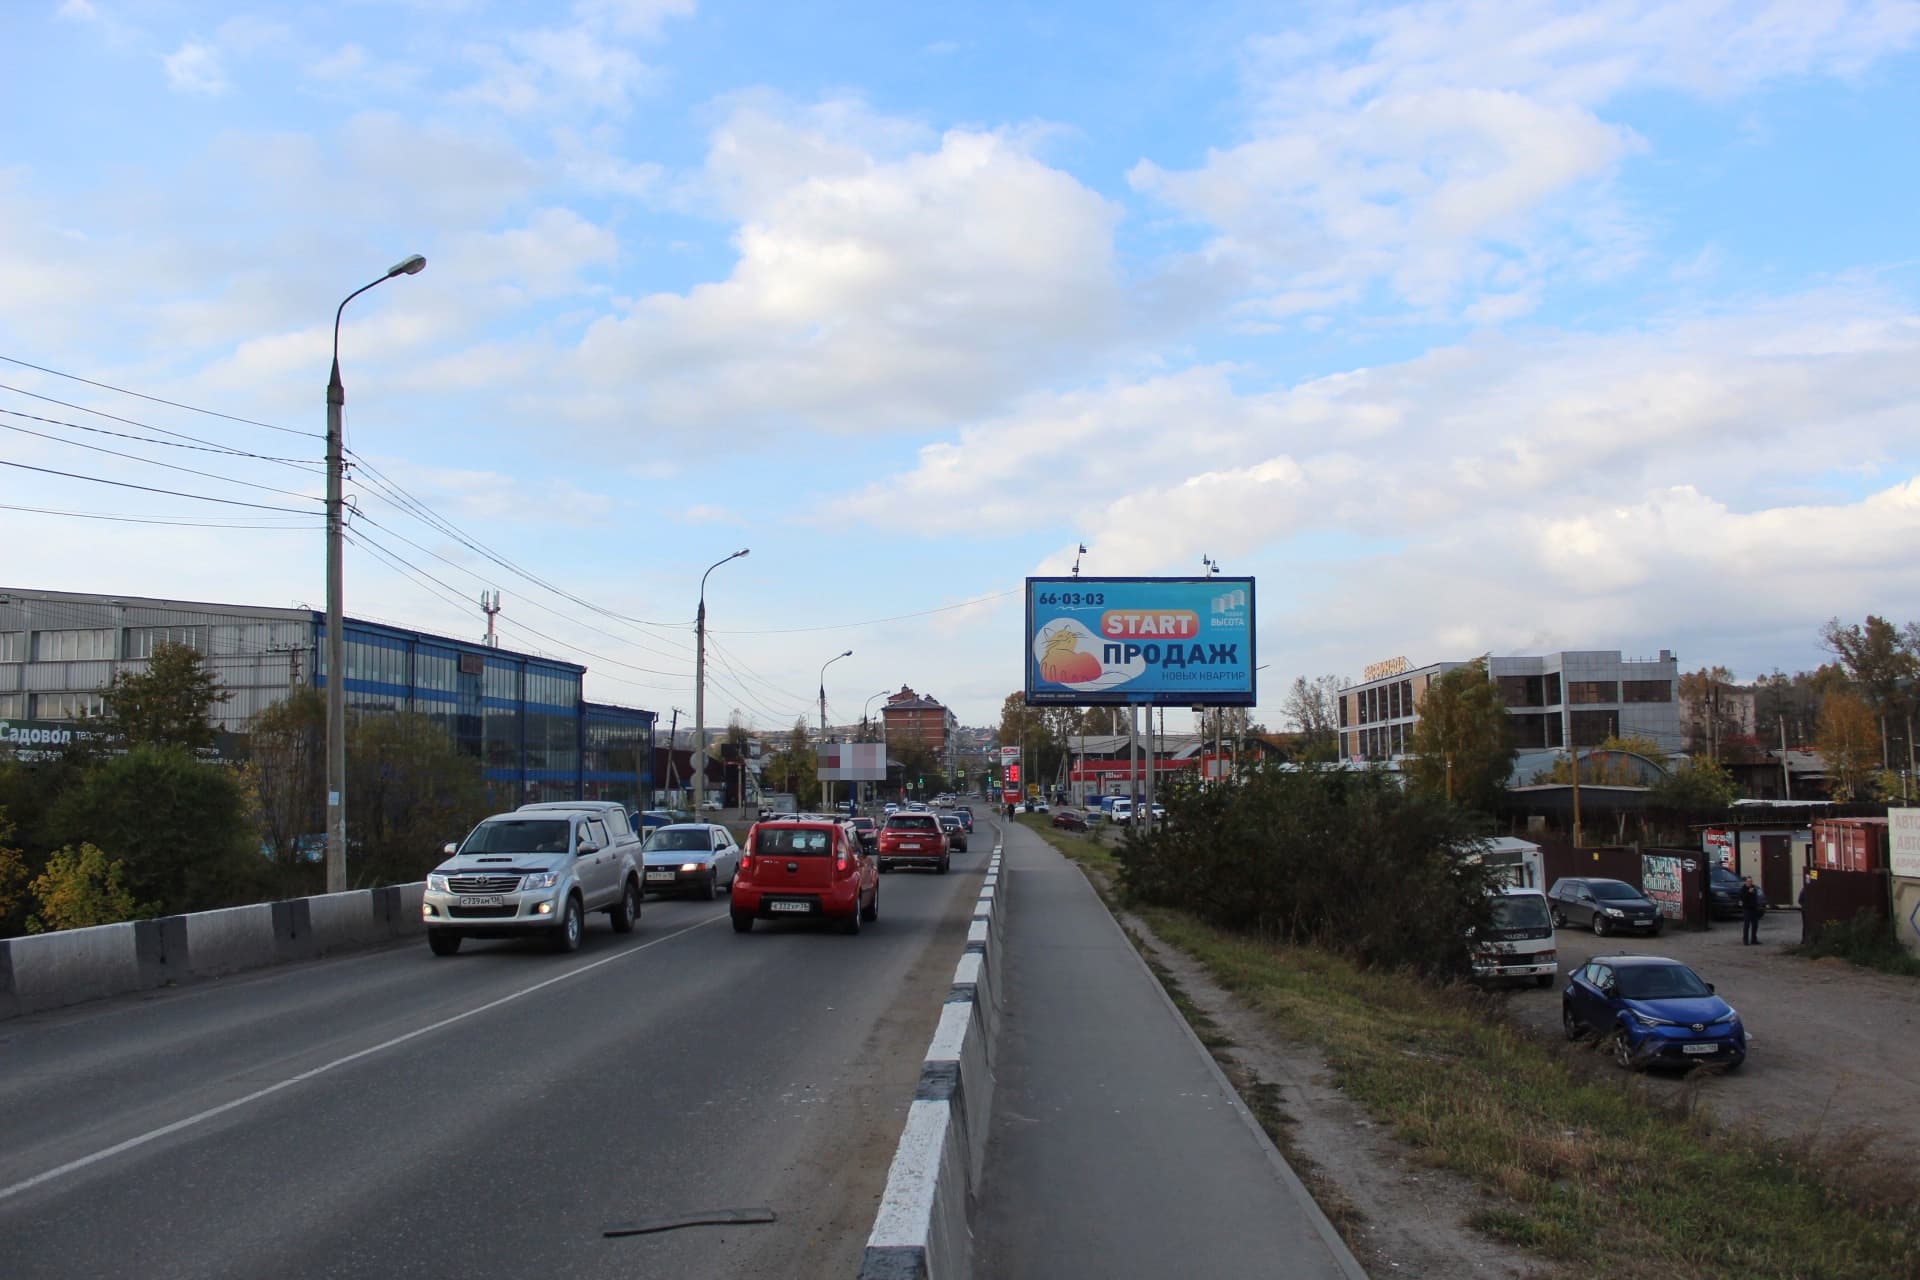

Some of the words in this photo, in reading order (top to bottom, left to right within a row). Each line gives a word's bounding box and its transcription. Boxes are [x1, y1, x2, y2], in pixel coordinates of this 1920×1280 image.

[1106, 615, 1193, 635] START
[1210, 618, 1245, 627] ВЫСОТА
[1103, 643, 1238, 669] ПРОДАЖ
[1162, 671, 1198, 681] НОВЫХ
[1199, 671, 1246, 681] КВАРТИР
